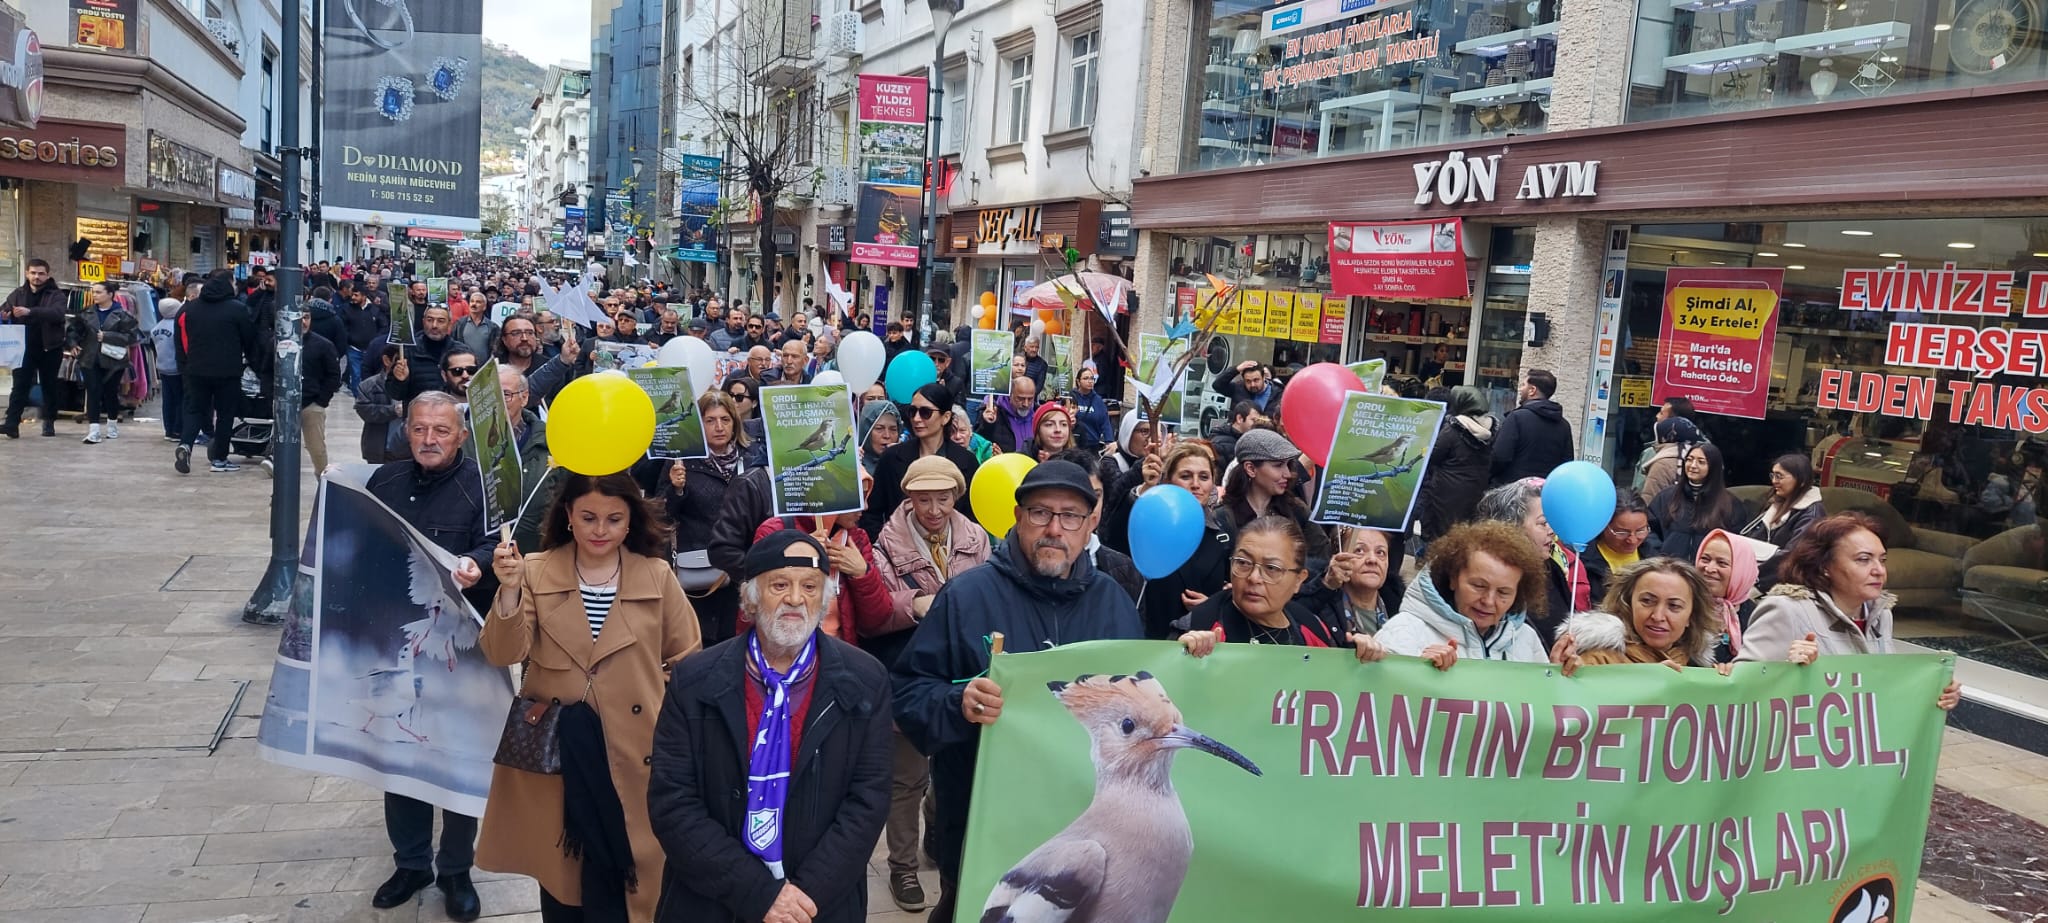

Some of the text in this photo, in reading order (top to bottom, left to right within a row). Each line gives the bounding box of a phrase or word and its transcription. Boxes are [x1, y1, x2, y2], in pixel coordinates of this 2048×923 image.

[101, 10, 124, 19] TOSTU
[1286, 10, 1413, 59] EN UYGUN FİYATLARLA
[1263, 29, 1440, 92] HİÇ PEŞİNATSIZ ELDEN TAKSİTLİ
[876, 83, 912, 94] KUZEY
[875, 94, 912, 105] YILDIZI
[871, 105, 914, 117] TEKNESİ
[378, 154, 463, 176] DIAMOND
[348, 172, 456, 190] NEDİM ŞAHİN MÜCEVHER
[1413, 152, 1601, 205] YÖN AVM
[371, 190, 378, 198] T:
[398, 192, 410, 201] 715
[413, 194, 421, 202] 52
[425, 194, 434, 203] 52
[975, 208, 1040, 250] SEÇ-AL
[1384, 232, 1404, 245] YÖN
[82, 264, 100, 276] 100
[1839, 261, 2016, 317] EVİNİZE
[1686, 297, 1757, 313] Şimdi Al,
[1679, 315, 1686, 325] 3
[1690, 316, 1707, 328] Ay
[1690, 343, 1730, 355] Mart'da
[1674, 354, 1753, 373] 12 Taksitle
[1681, 370, 1740, 383] Rahatça Öde.
[1622, 393, 1634, 405] 15
[1817, 369, 2048, 433] ELDEN TAKS
[773, 403, 801, 411] MELET
[1356, 402, 1385, 412] ORDU
[774, 410, 834, 418] YAPILAŞMAYA
[1353, 410, 1423, 425] MELET IRMAĞI
[777, 418, 823, 428] AÇILMASIN
[1352, 419, 1417, 432] YAPILAŞMAYA
[1348, 428, 1401, 438] AÇILMASIN
[1271, 672, 1910, 784] “RANTIN BETONU DEĞİL,
[1356, 802, 1850, 915] MELET’İN KUŞLARI
